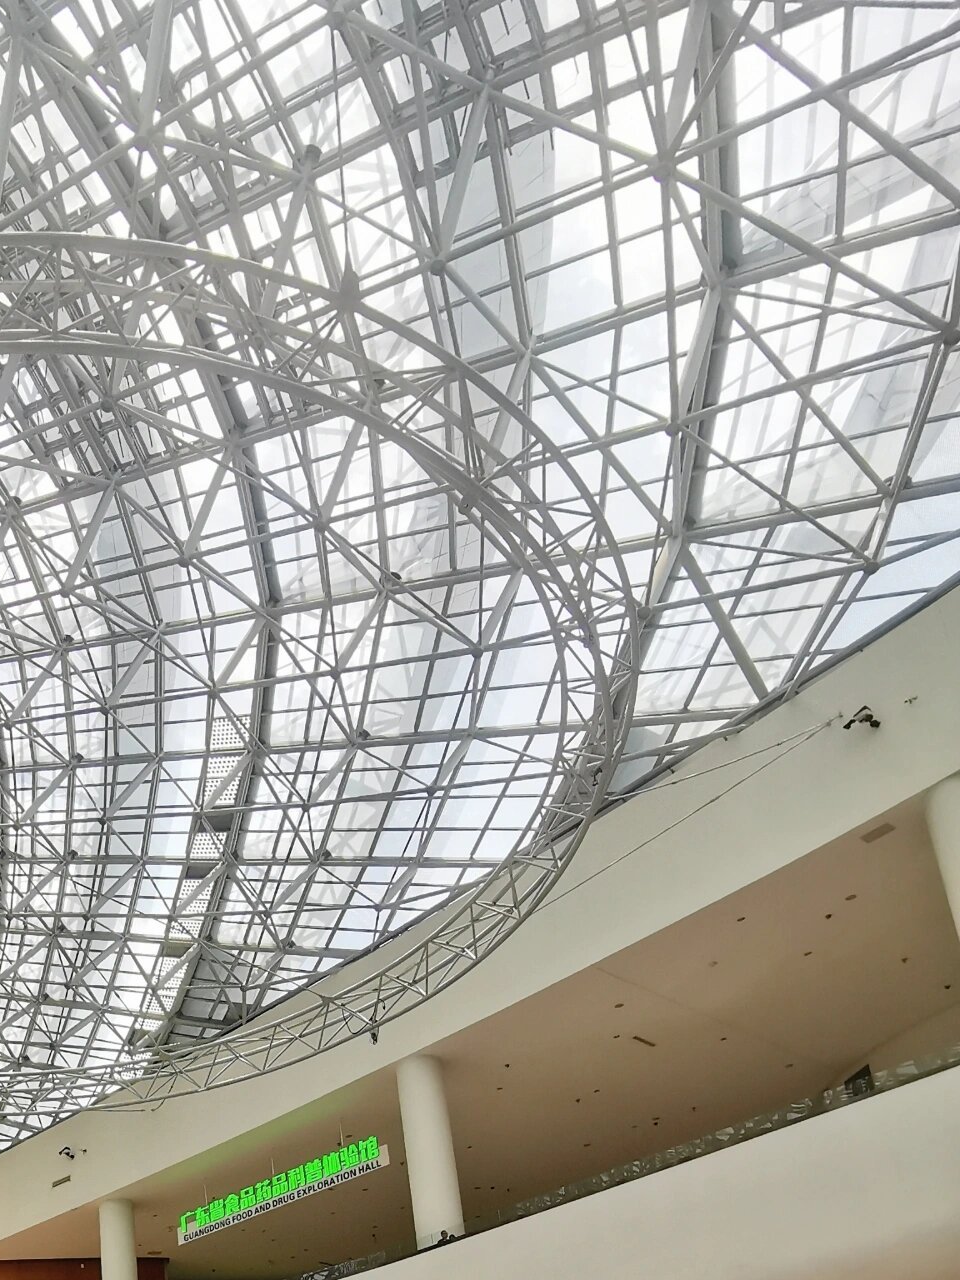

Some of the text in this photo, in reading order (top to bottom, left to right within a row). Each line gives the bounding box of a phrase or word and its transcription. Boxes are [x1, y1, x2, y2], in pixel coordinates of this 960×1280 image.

[183, 1160, 381, 1242] GUANGDONG FOOD AND DRUG EXPLORATION HALL
